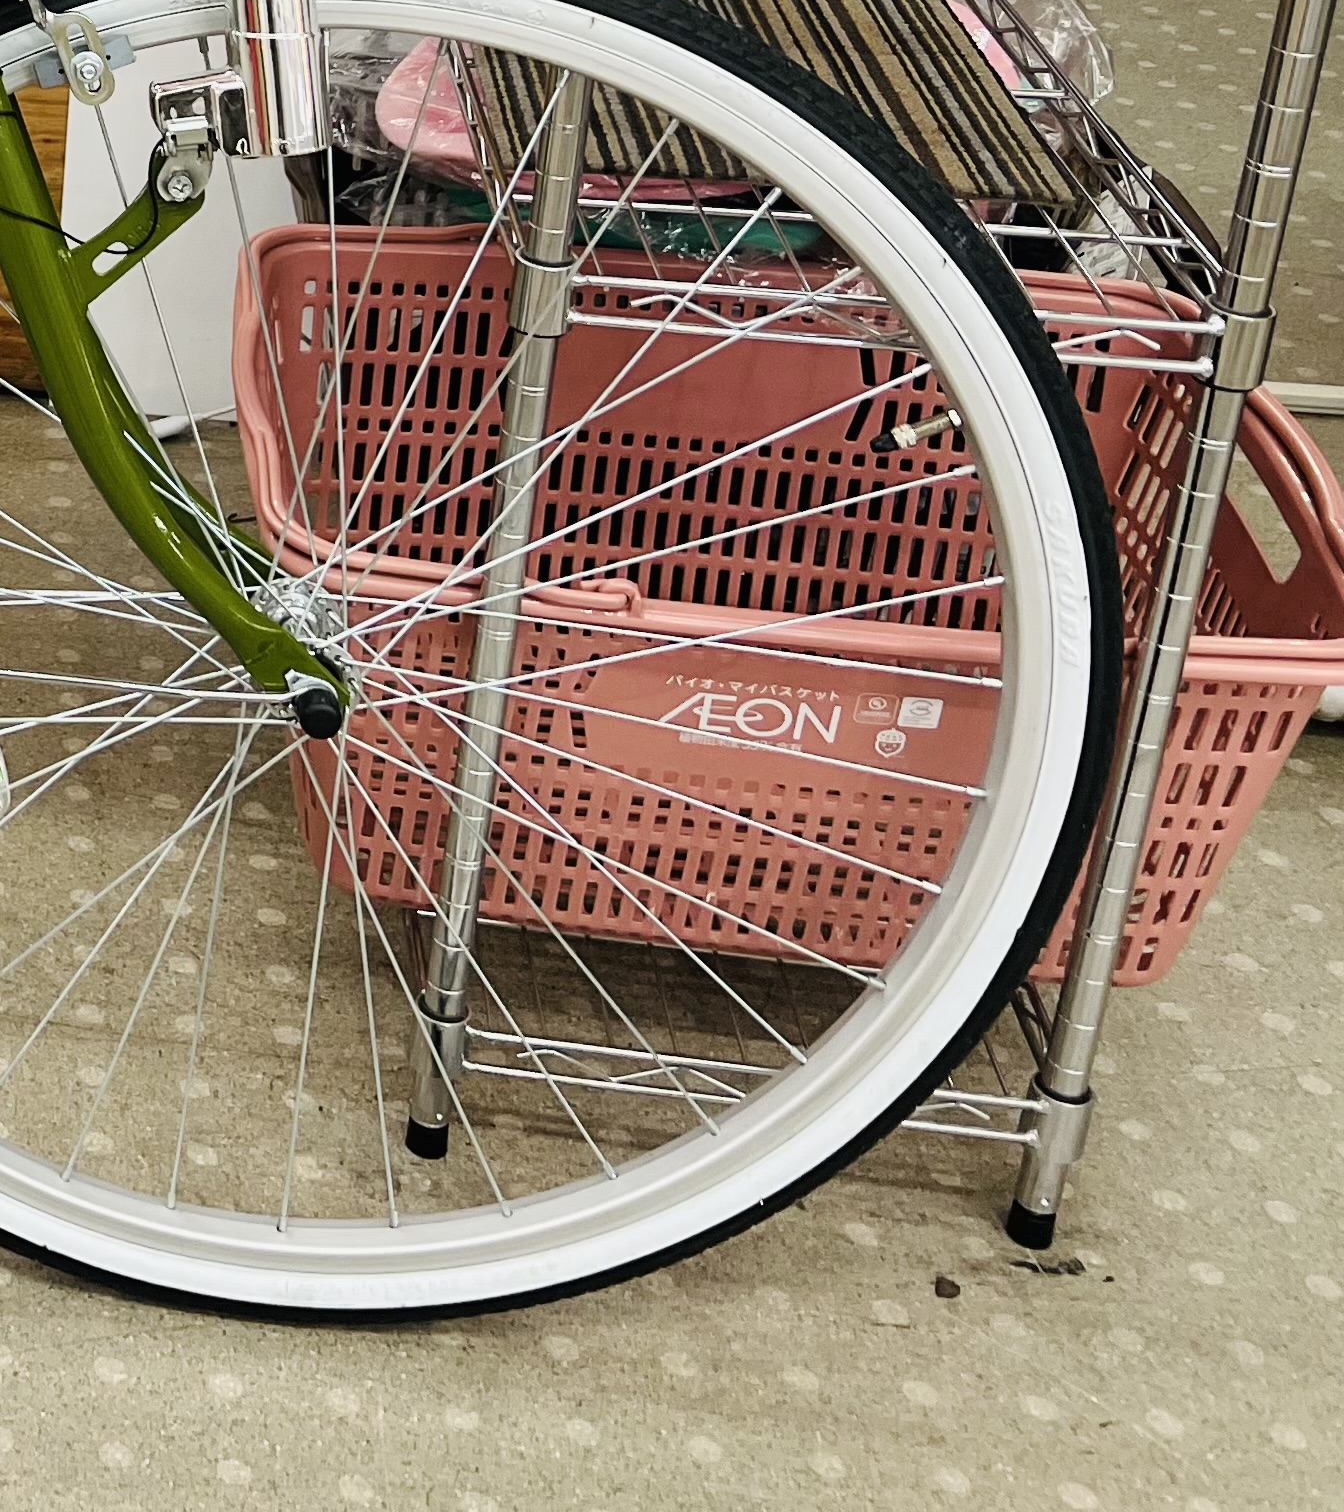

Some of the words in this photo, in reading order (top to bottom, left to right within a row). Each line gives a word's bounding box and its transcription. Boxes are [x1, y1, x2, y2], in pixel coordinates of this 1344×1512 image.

[1042, 499, 1081, 669] SAKURA
[665, 674, 840, 702] バイオ・マイバスケット
